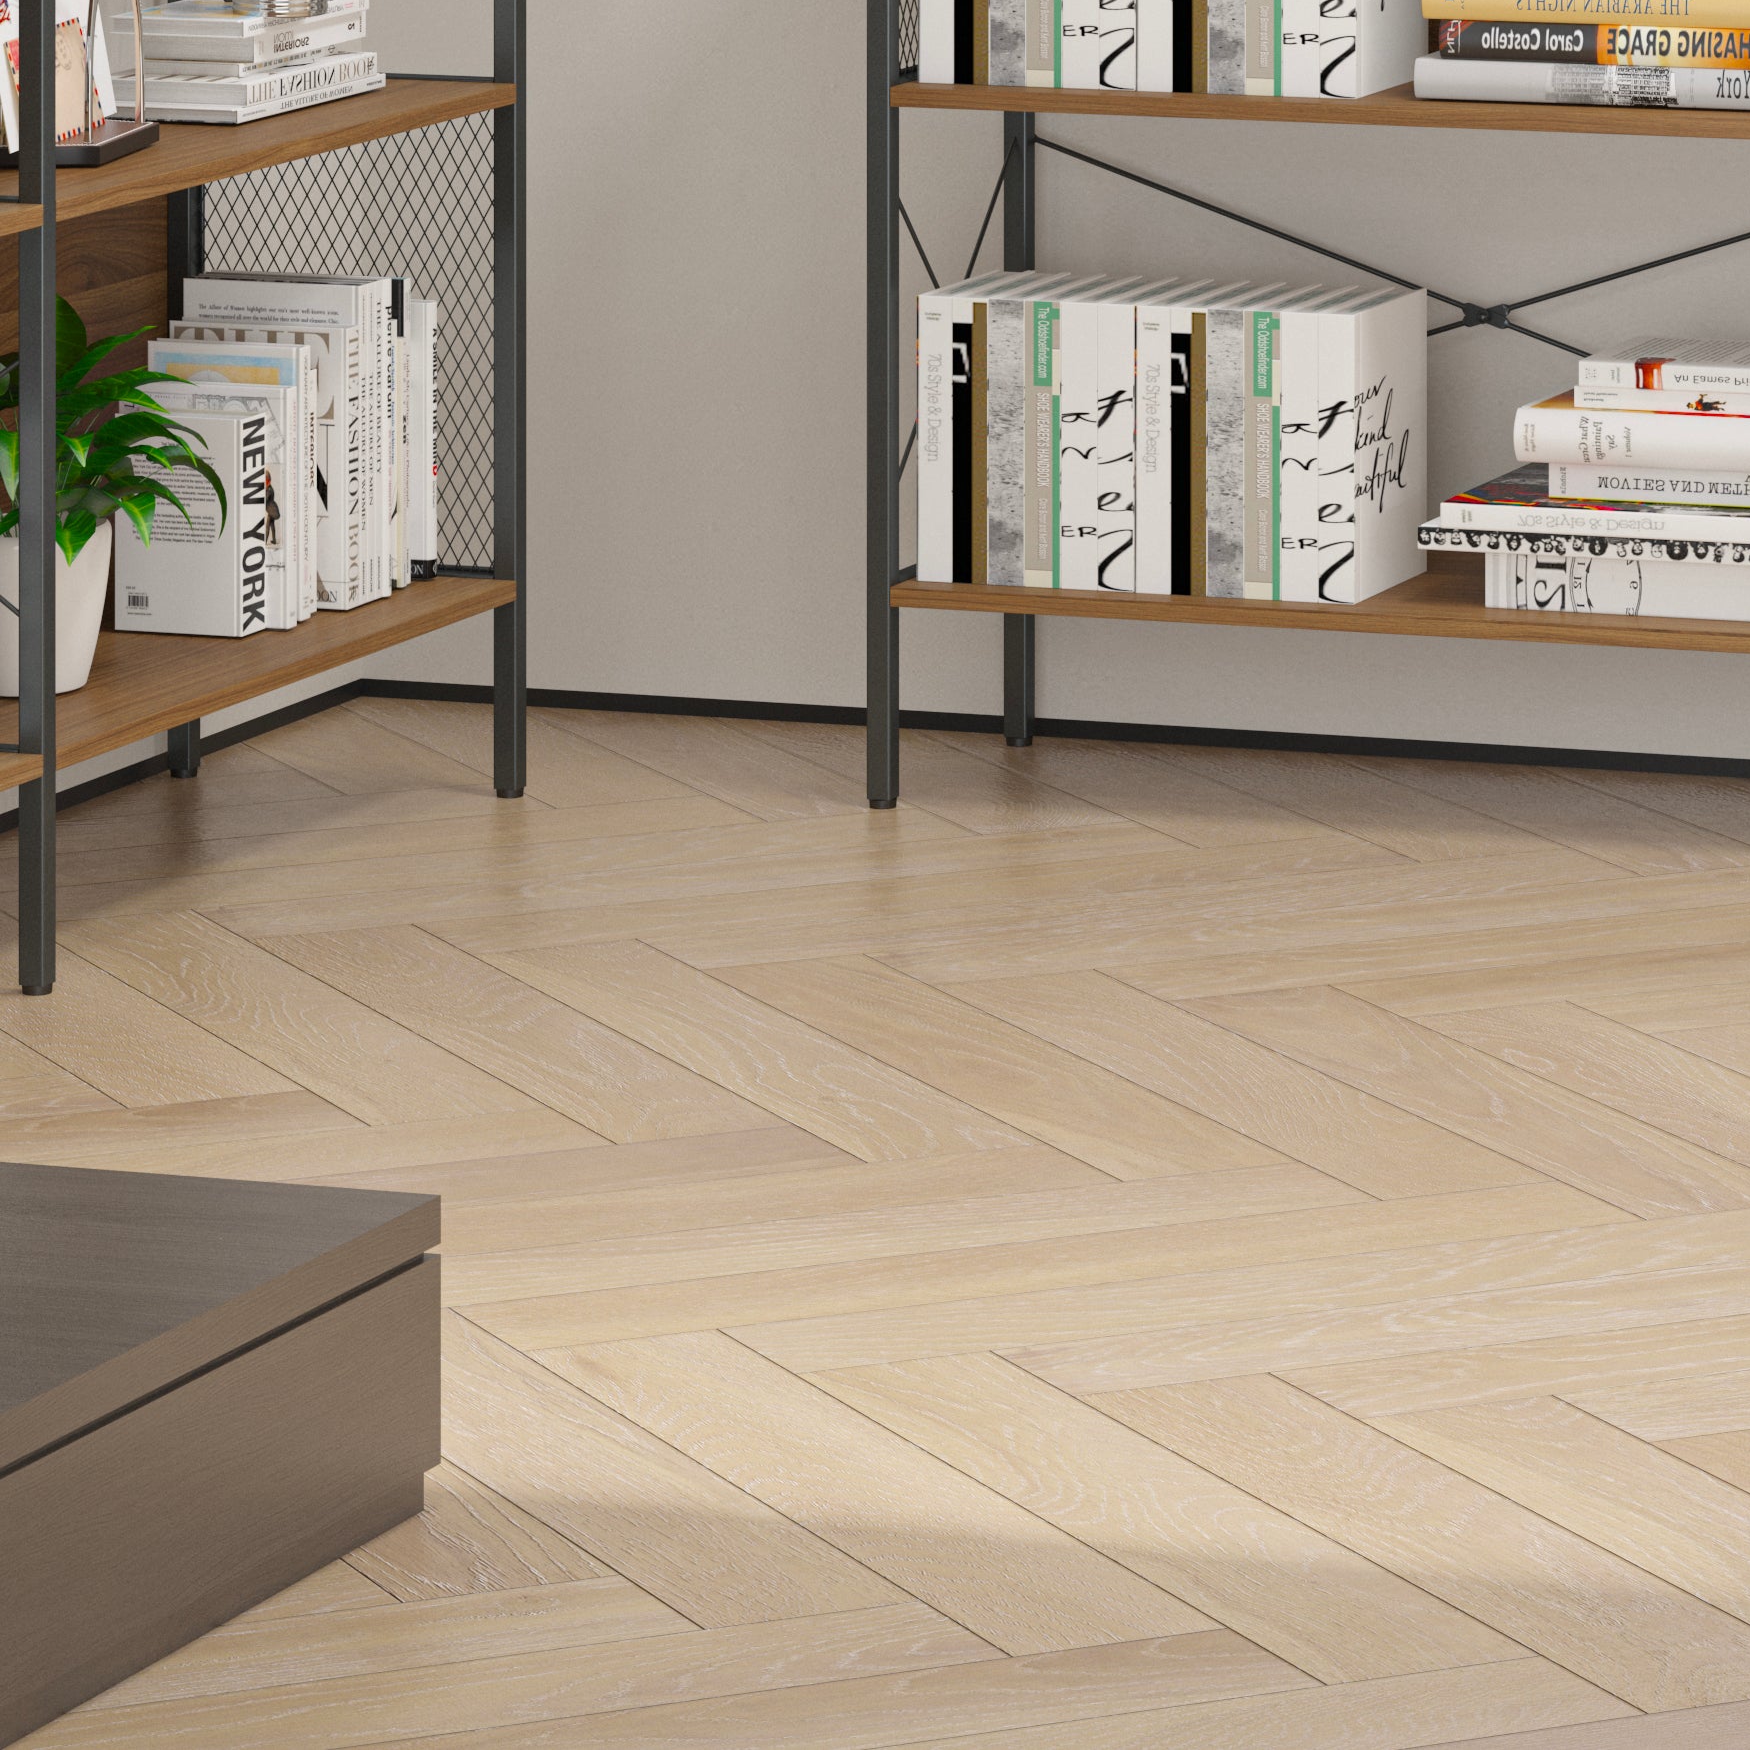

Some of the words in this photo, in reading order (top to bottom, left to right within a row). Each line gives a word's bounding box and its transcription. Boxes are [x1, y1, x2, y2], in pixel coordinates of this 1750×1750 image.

[1038, 307, 1050, 318] The
[1258, 318, 1269, 330] The
[349, 330, 359, 388] THE
[929, 354, 942, 372] 70s
[1038, 319, 1050, 378] Oddshoefinder.com
[1257, 330, 1270, 390] Oddshoefinder.com
[926, 373, 942, 404] Style
[1147, 364, 1160, 384] 70s
[929, 406, 942, 416] &
[1036, 392, 1050, 410] SHOE
[1144, 384, 1160, 416] Style
[1256, 403, 1270, 421] SHOE
[1036, 410, 1050, 443] WEARER'S
[1148, 418, 1160, 428] &
[1256, 422, 1270, 454] WEARER'S
[349, 395, 359, 516] FASHION
[926, 420, 942, 462] Design
[1143, 431, 1160, 474] Design
[242, 415, 266, 504] NEW
[1036, 444, 1050, 487] HANDBOOK
[1256, 454, 1270, 499] HANDBOOK
[242, 516, 266, 632] YORK
